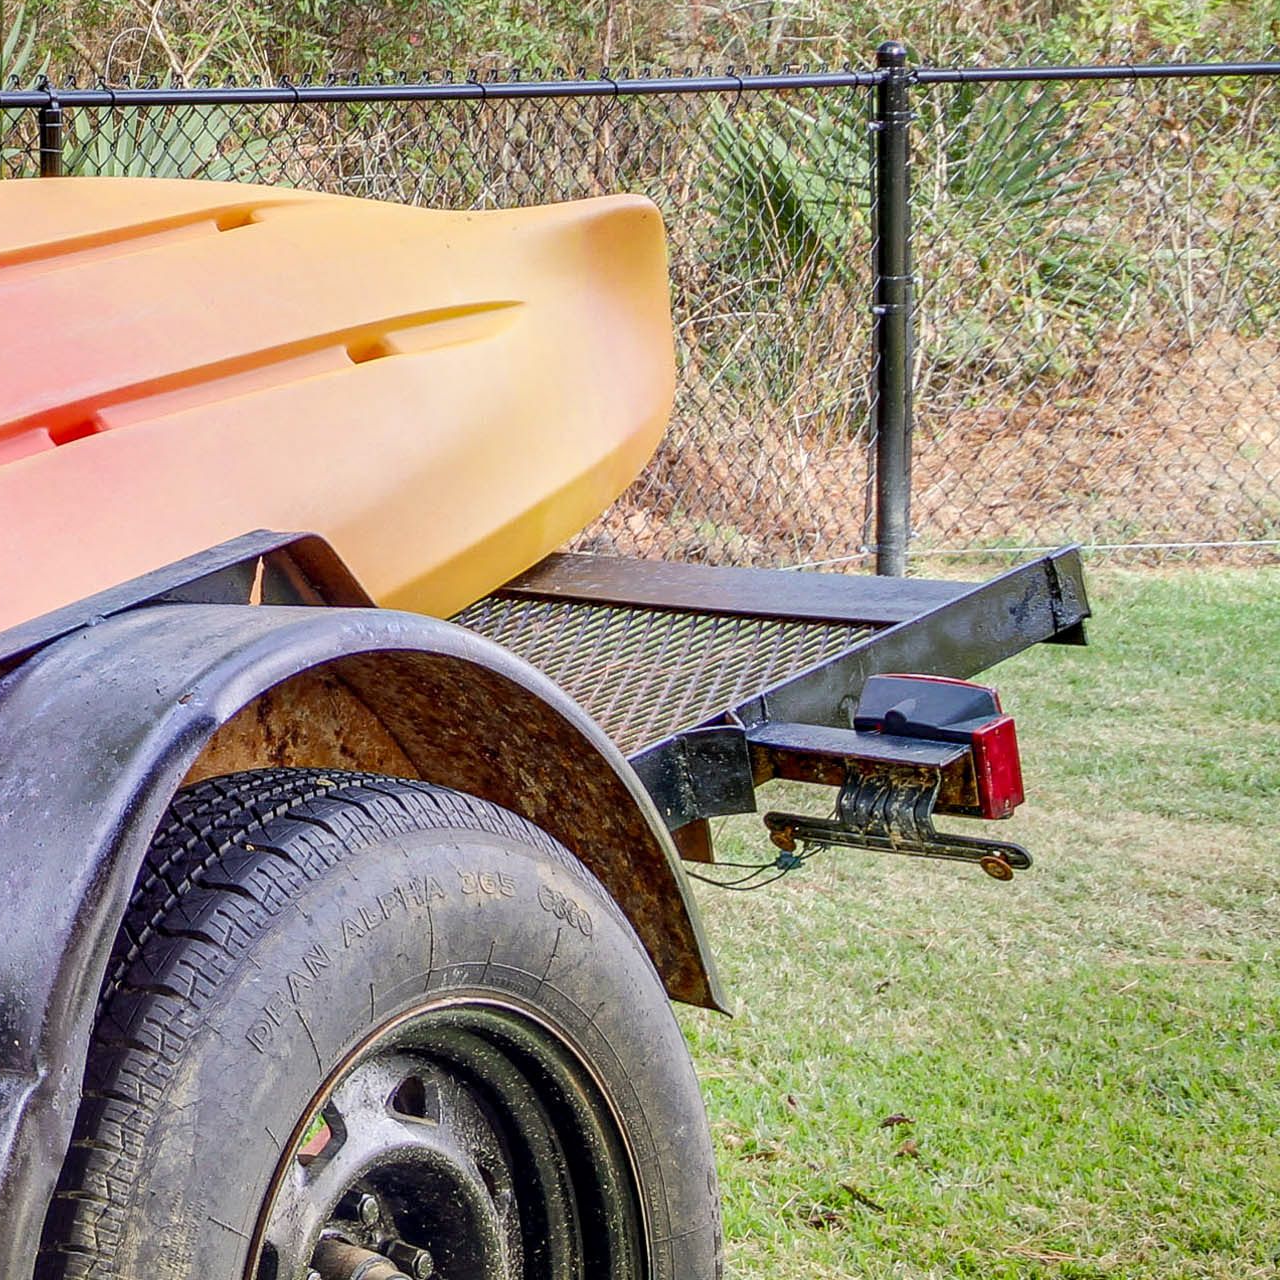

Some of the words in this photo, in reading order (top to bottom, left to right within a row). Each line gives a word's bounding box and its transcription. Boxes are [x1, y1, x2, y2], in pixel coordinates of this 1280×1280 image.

[245, 943, 332, 1054] DEAN
[341, 875, 445, 949] ALPHA
[460, 871, 517, 898] 365
